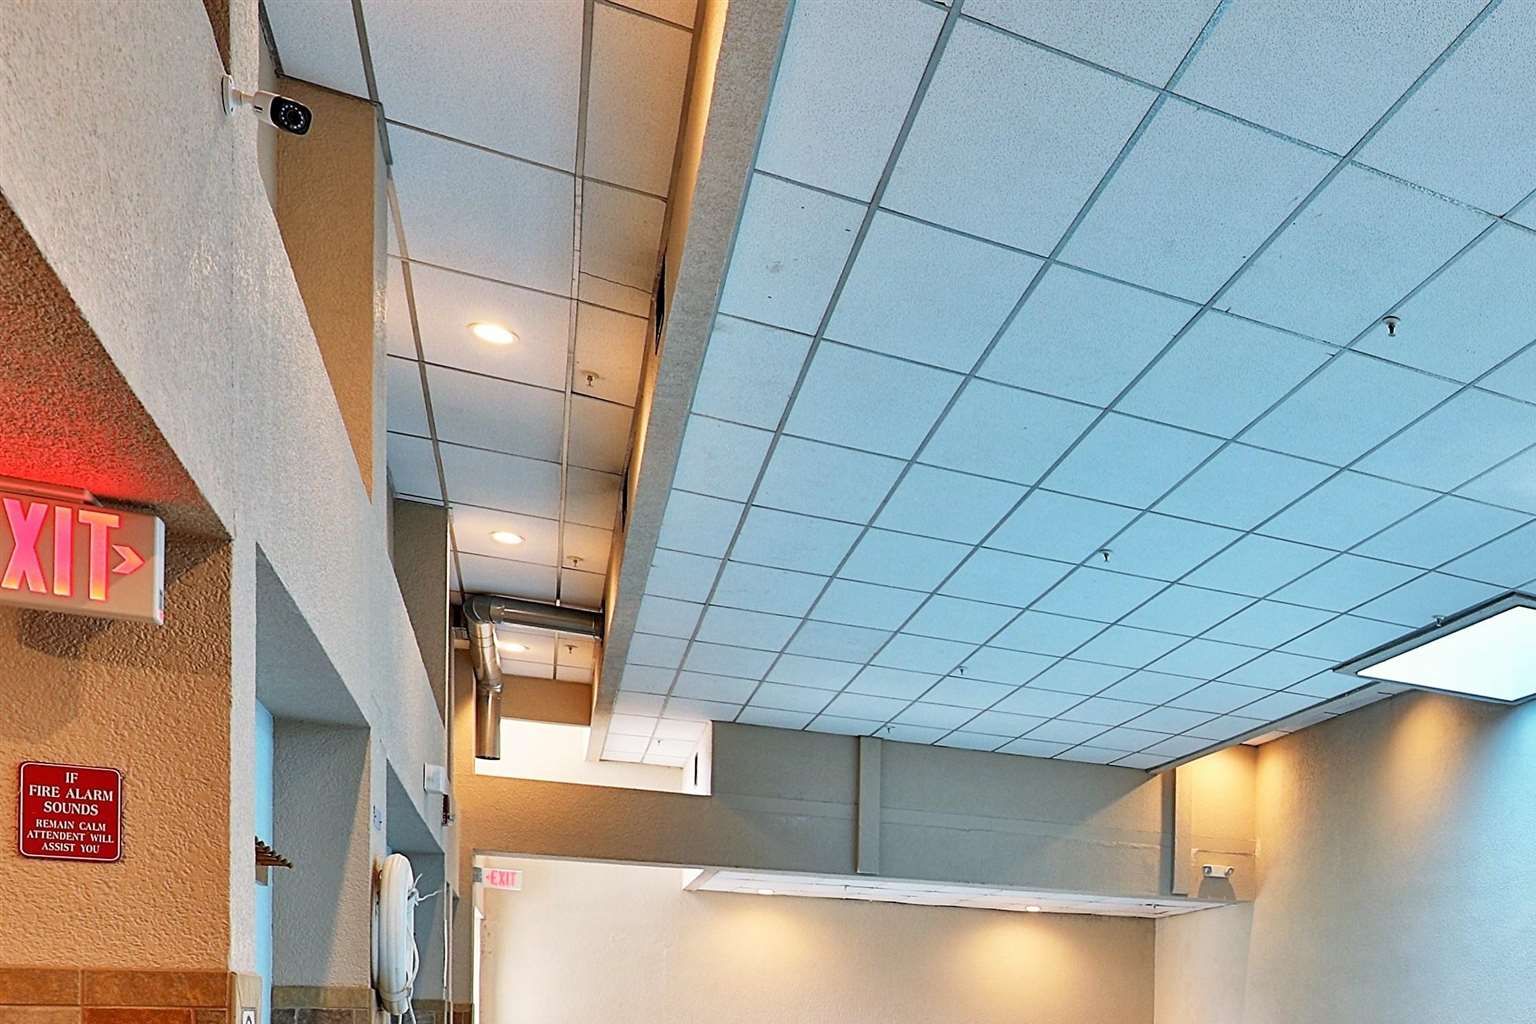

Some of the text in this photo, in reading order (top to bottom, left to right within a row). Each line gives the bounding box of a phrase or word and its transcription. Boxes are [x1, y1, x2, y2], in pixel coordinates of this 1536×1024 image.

[65, 772, 79, 784] IF
[29, 784, 113, 802] FIRE ALARM
[43, 800, 99, 816] SOUNDS
[36, 819, 106, 832] REMAIN CALM
[27, 830, 114, 843] ATTENDENT WILL
[42, 842, 100, 853] ASSIST YOU
[491, 870, 516, 887] EXIT
